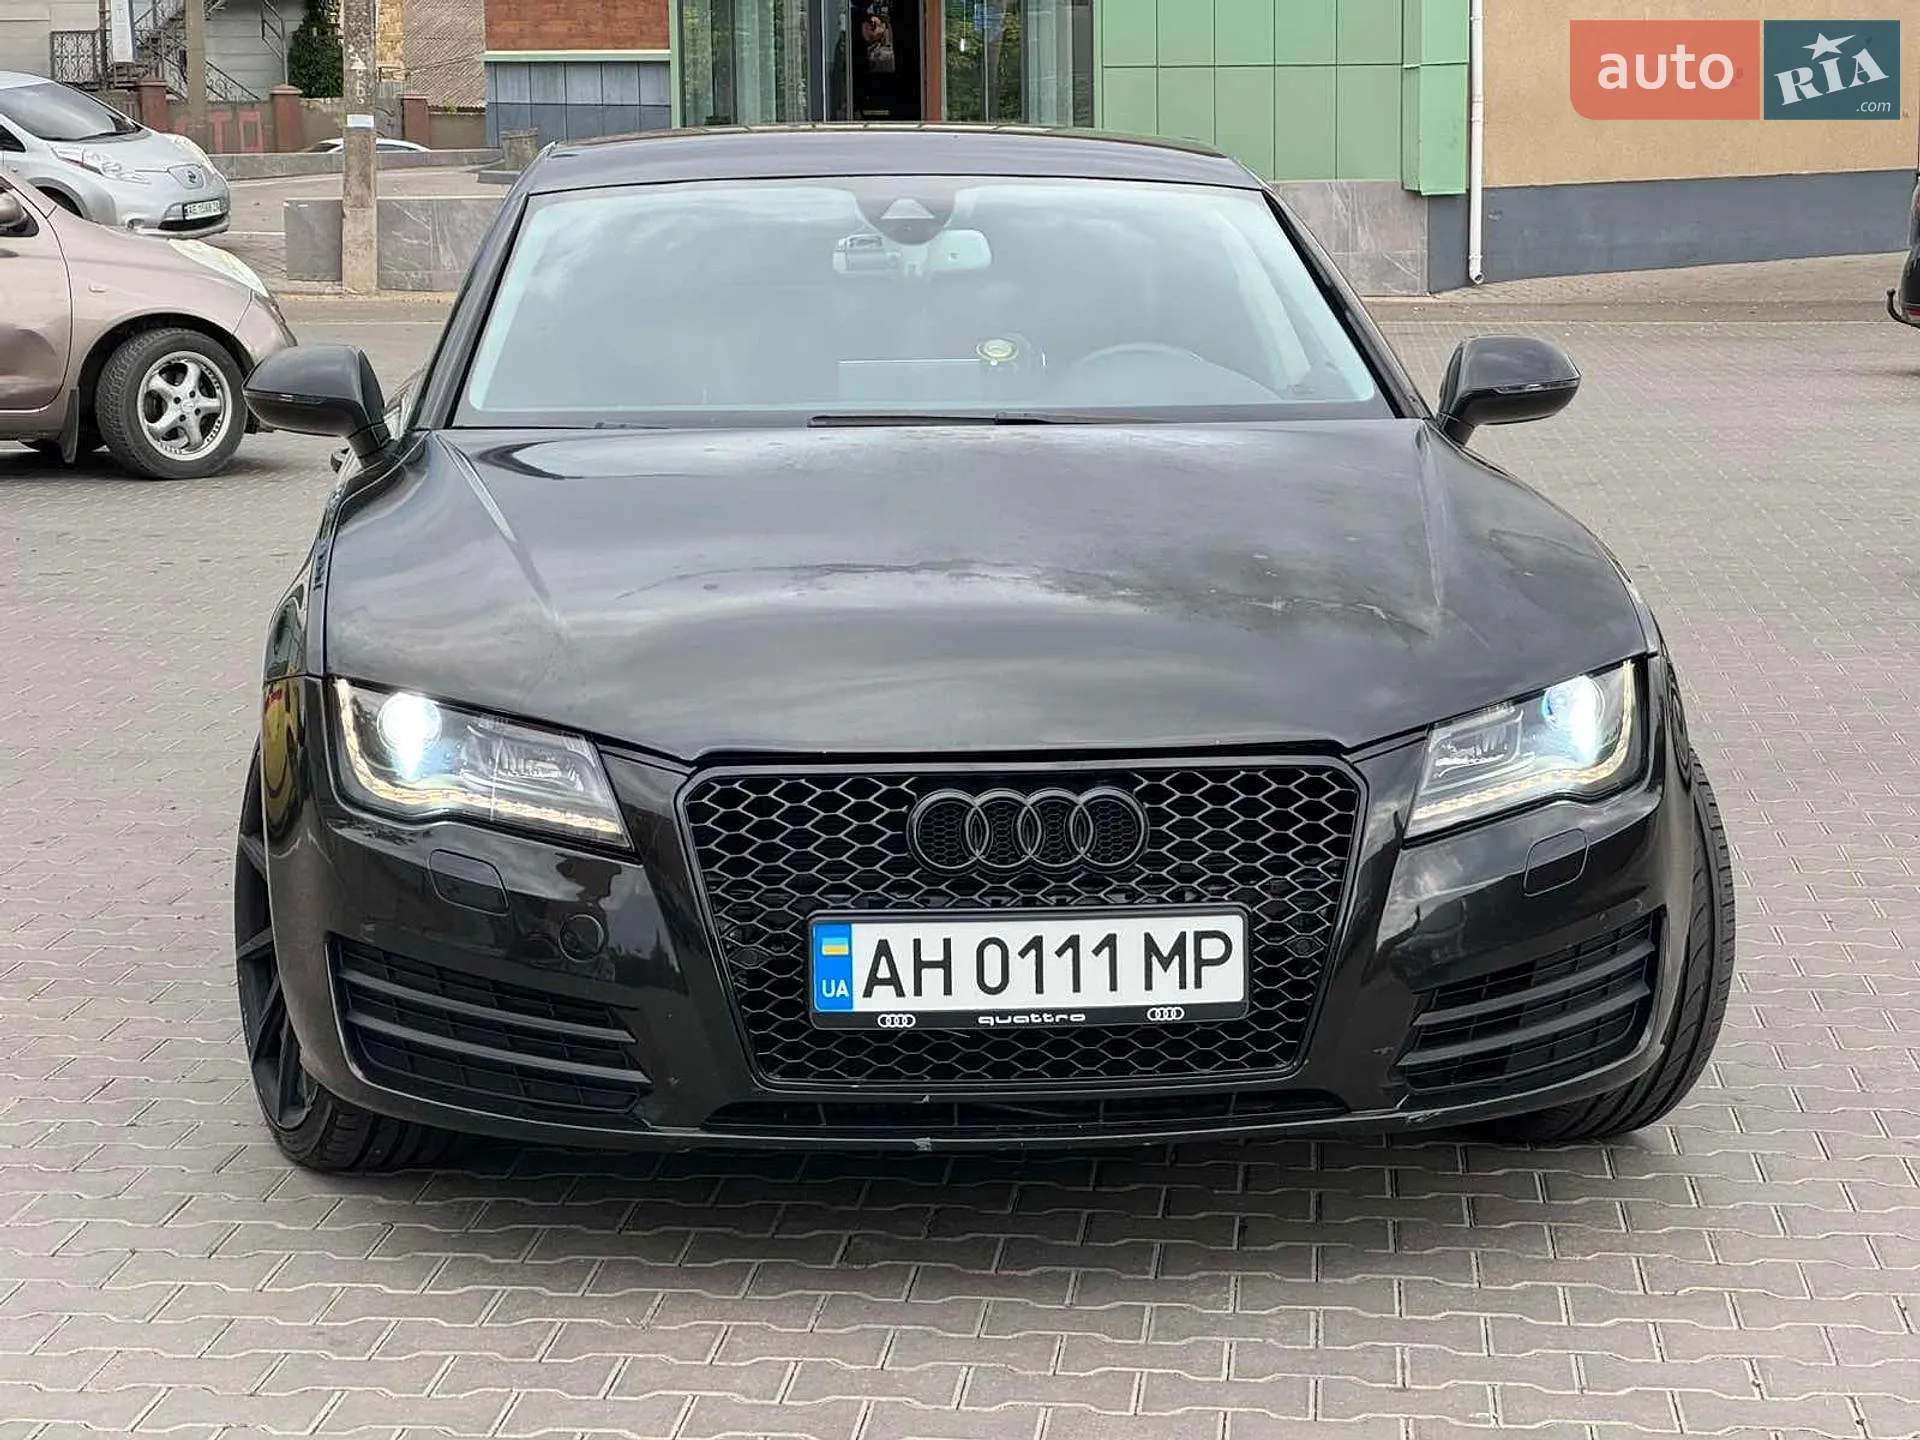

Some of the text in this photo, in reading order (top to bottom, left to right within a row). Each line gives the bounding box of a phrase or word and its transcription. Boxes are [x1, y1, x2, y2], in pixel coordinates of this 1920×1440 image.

[862, 929, 1233, 998] AH 0111 MP
[822, 979, 850, 998] UA
[977, 1012, 1087, 1026] quattro
